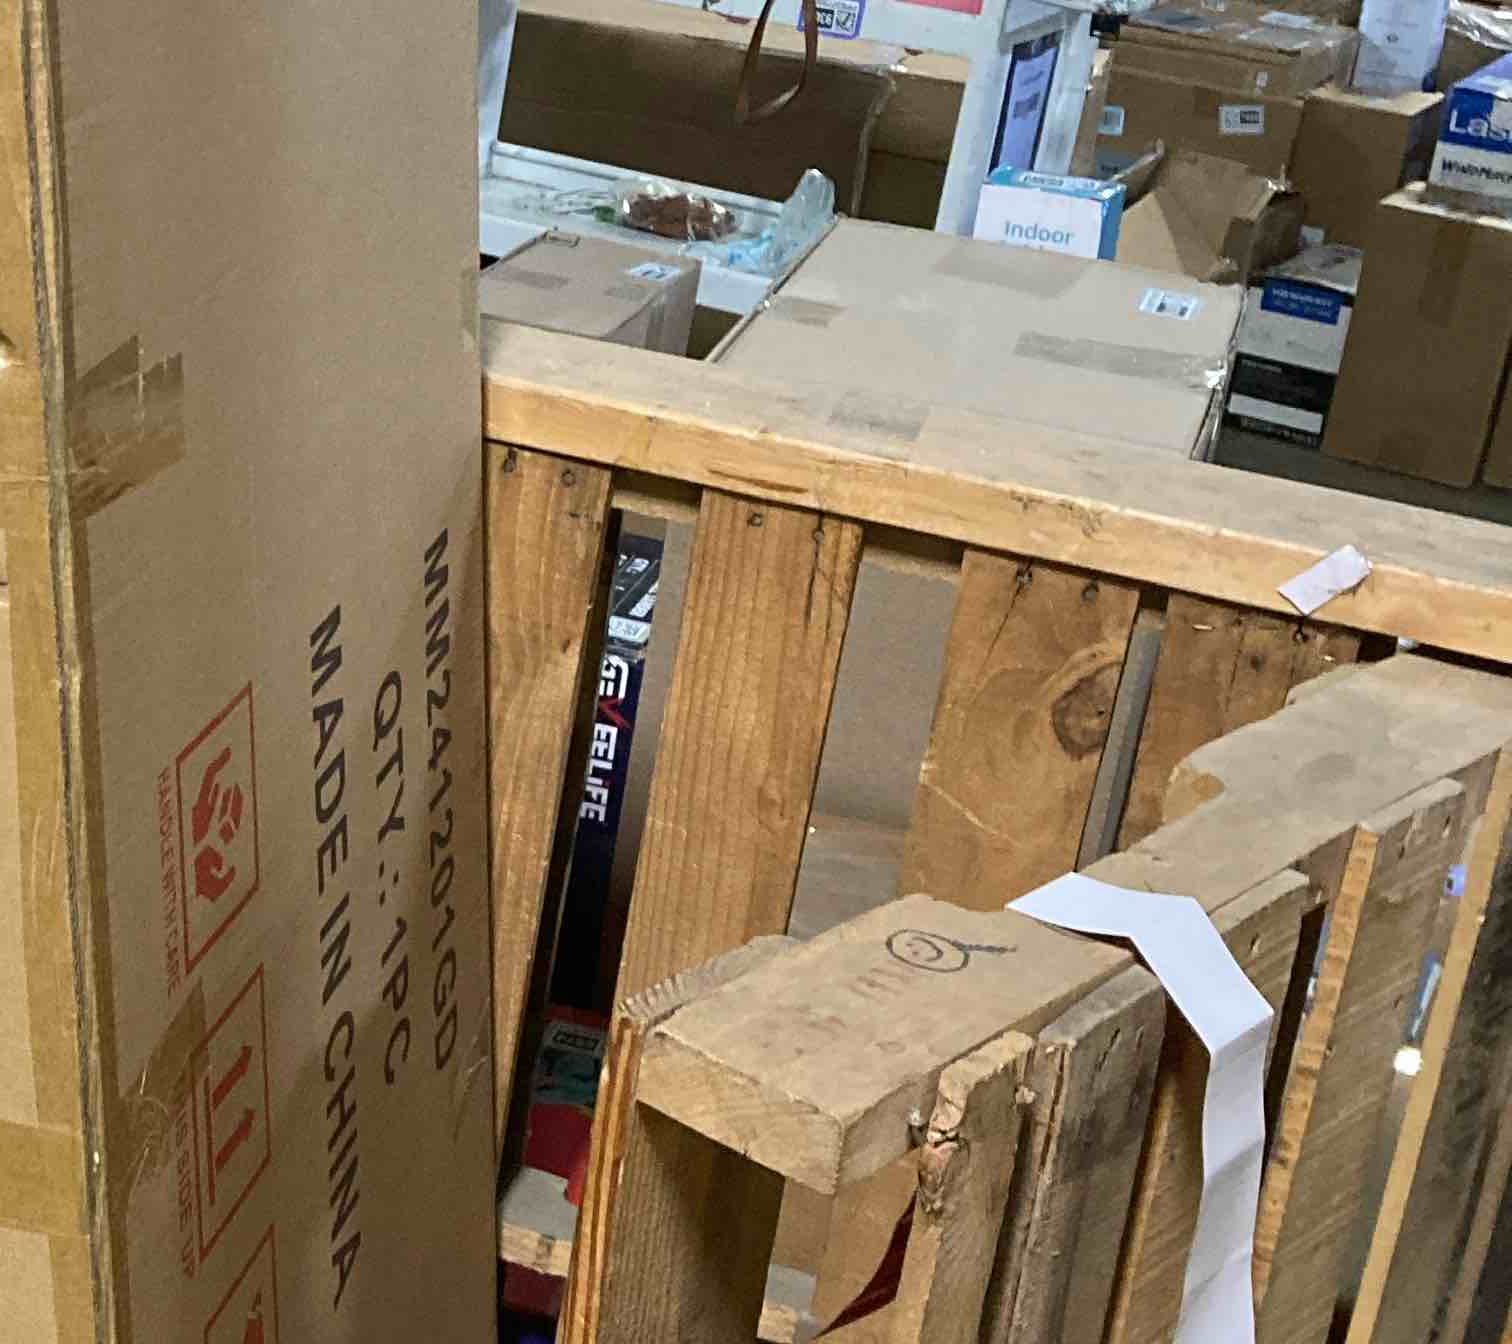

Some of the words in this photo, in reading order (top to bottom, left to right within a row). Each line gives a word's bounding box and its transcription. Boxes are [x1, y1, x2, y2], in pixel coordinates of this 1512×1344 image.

[1004, 221, 1072, 245] Indoor
[310, 605, 349, 896] MADE
[424, 527, 458, 1071] MM241201GD
[157, 767, 177, 866] HANDLE
[160, 866, 180, 929] WITH
[319, 892, 352, 1006] IN
[163, 930, 184, 1000] CARE
[379, 917, 411, 1087] 1PC
[323, 1009, 362, 1312] CHINA
